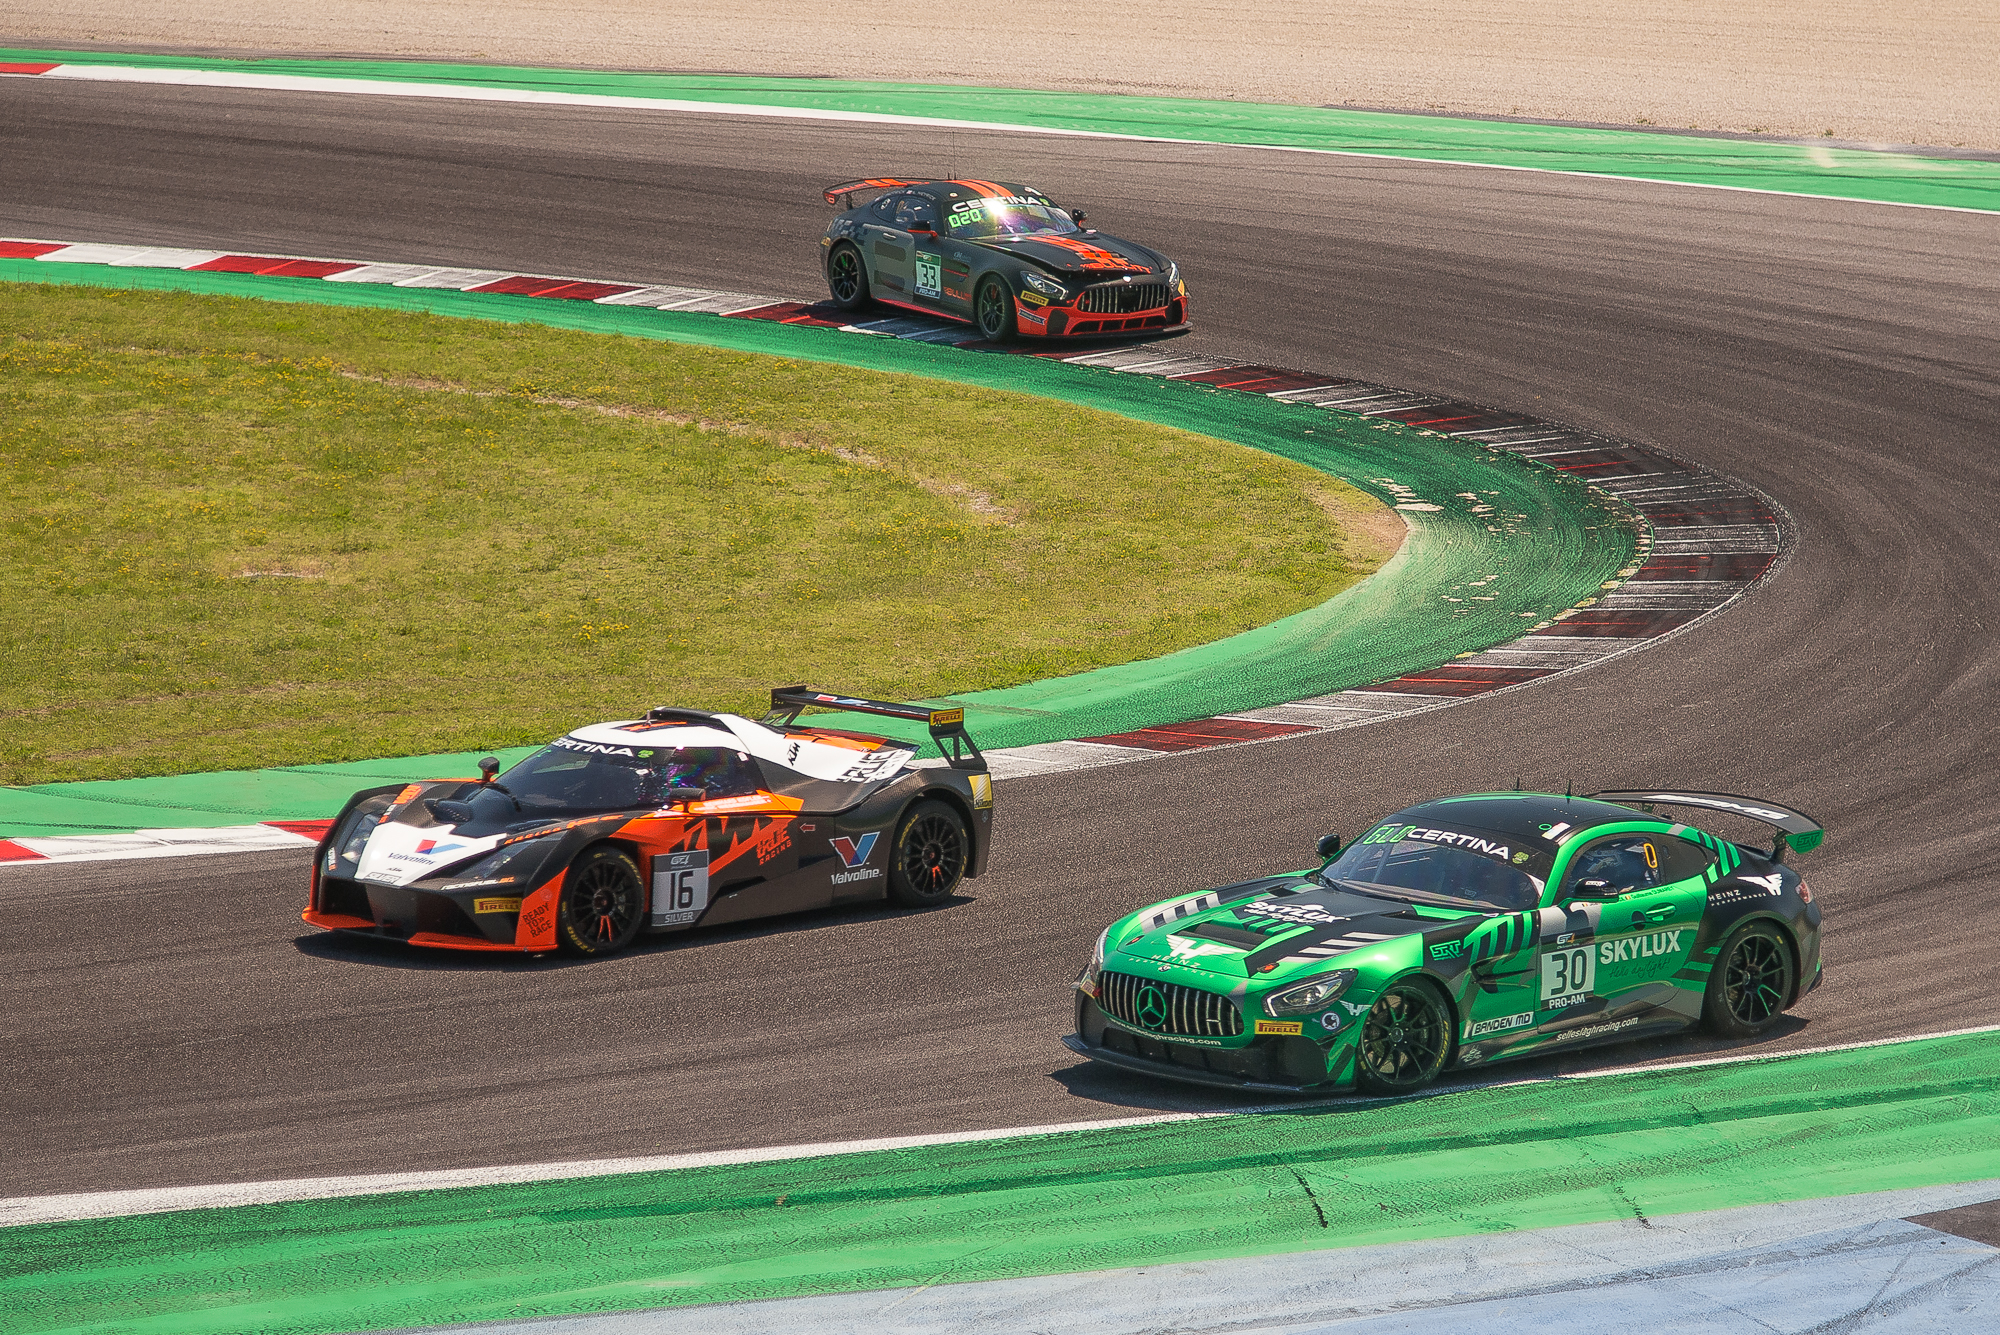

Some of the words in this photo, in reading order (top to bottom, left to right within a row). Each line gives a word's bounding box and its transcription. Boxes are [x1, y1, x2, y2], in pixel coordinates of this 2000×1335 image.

[921, 264, 936, 289] 33
[919, 288, 936, 296] PRO-AM
[788, 742, 801, 766] KTM
[759, 839, 792, 866] RACING
[1407, 827, 1509, 860] CERTINA
[831, 868, 880, 885] Valvoline
[669, 871, 693, 911] 16
[1708, 889, 1741, 901] HEINZ
[479, 900, 518, 911] PIRELLI
[522, 902, 550, 923] READY
[664, 911, 694, 923] SILVER
[530, 919, 553, 938] RACE
[1557, 932, 1575, 945] GT4
[1600, 930, 1681, 965] SKYLUX
[1430, 940, 1461, 960] SRT
[1151, 954, 1201, 968] HEINZ
[1551, 949, 1587, 996] 30
[1549, 993, 1586, 1009] PRO-AM
[1259, 1022, 1299, 1033] PIRELLI
[1474, 1017, 1514, 1034] BANDEN
[1515, 1013, 1531, 1026] MD
